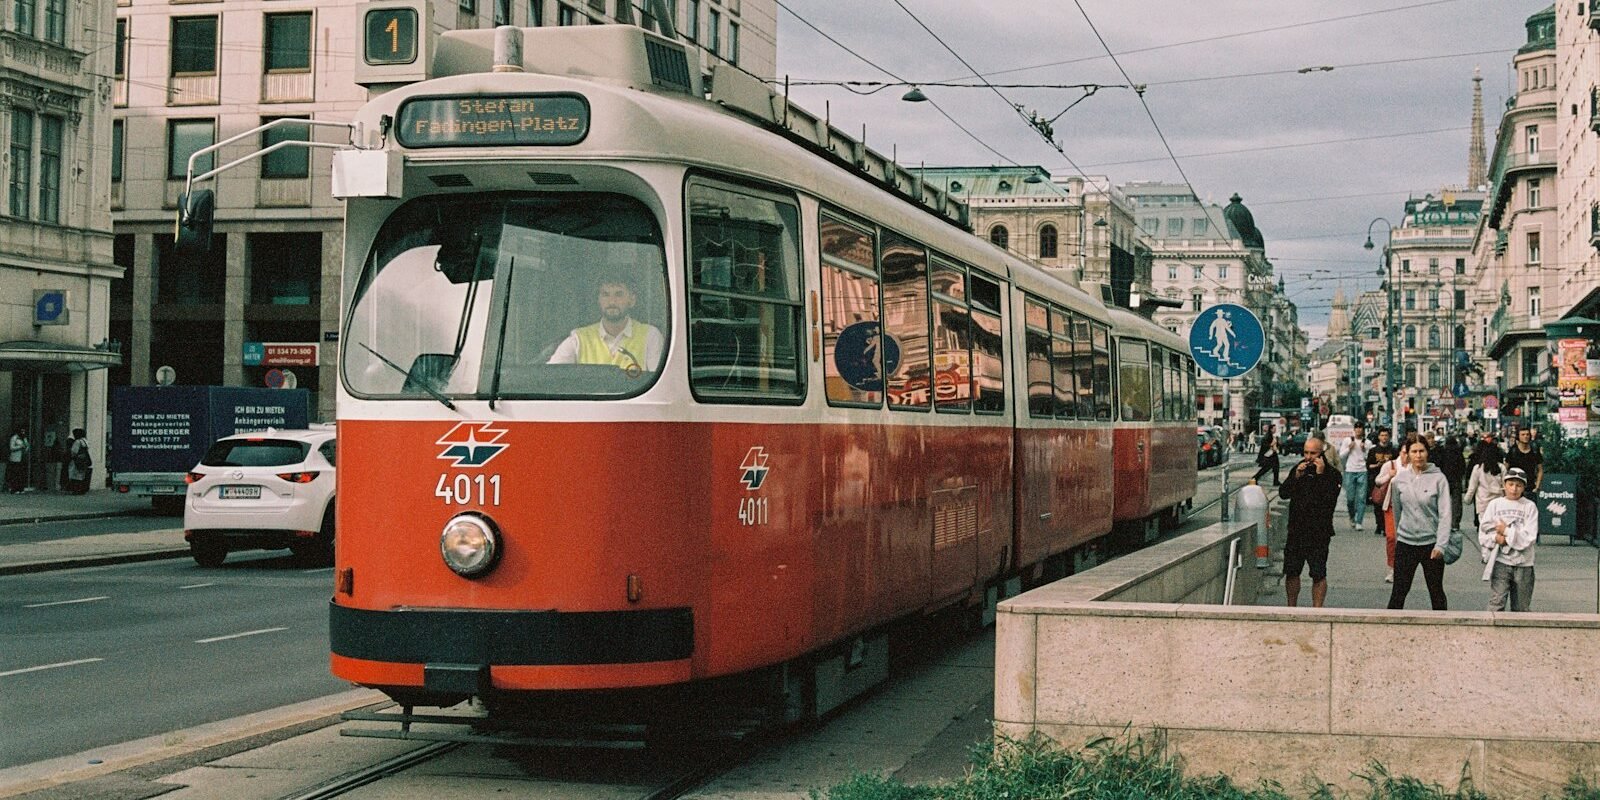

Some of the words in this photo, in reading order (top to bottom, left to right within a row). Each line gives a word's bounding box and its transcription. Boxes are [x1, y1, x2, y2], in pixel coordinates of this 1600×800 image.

[384, 17, 398, 53] 1
[460, 99, 535, 114] Stefan
[415, 116, 579, 135] Fadinger-Platz
[234, 406, 245, 414] ICH
[246, 406, 255, 414] BIN
[256, 406, 264, 414] ZU
[265, 406, 285, 414] MIETEN
[131, 428, 190, 436] BRUCKBERGER
[434, 473, 501, 506] 4011
[1539, 491, 1574, 499] Spareribs
[738, 496, 769, 527] 4011
